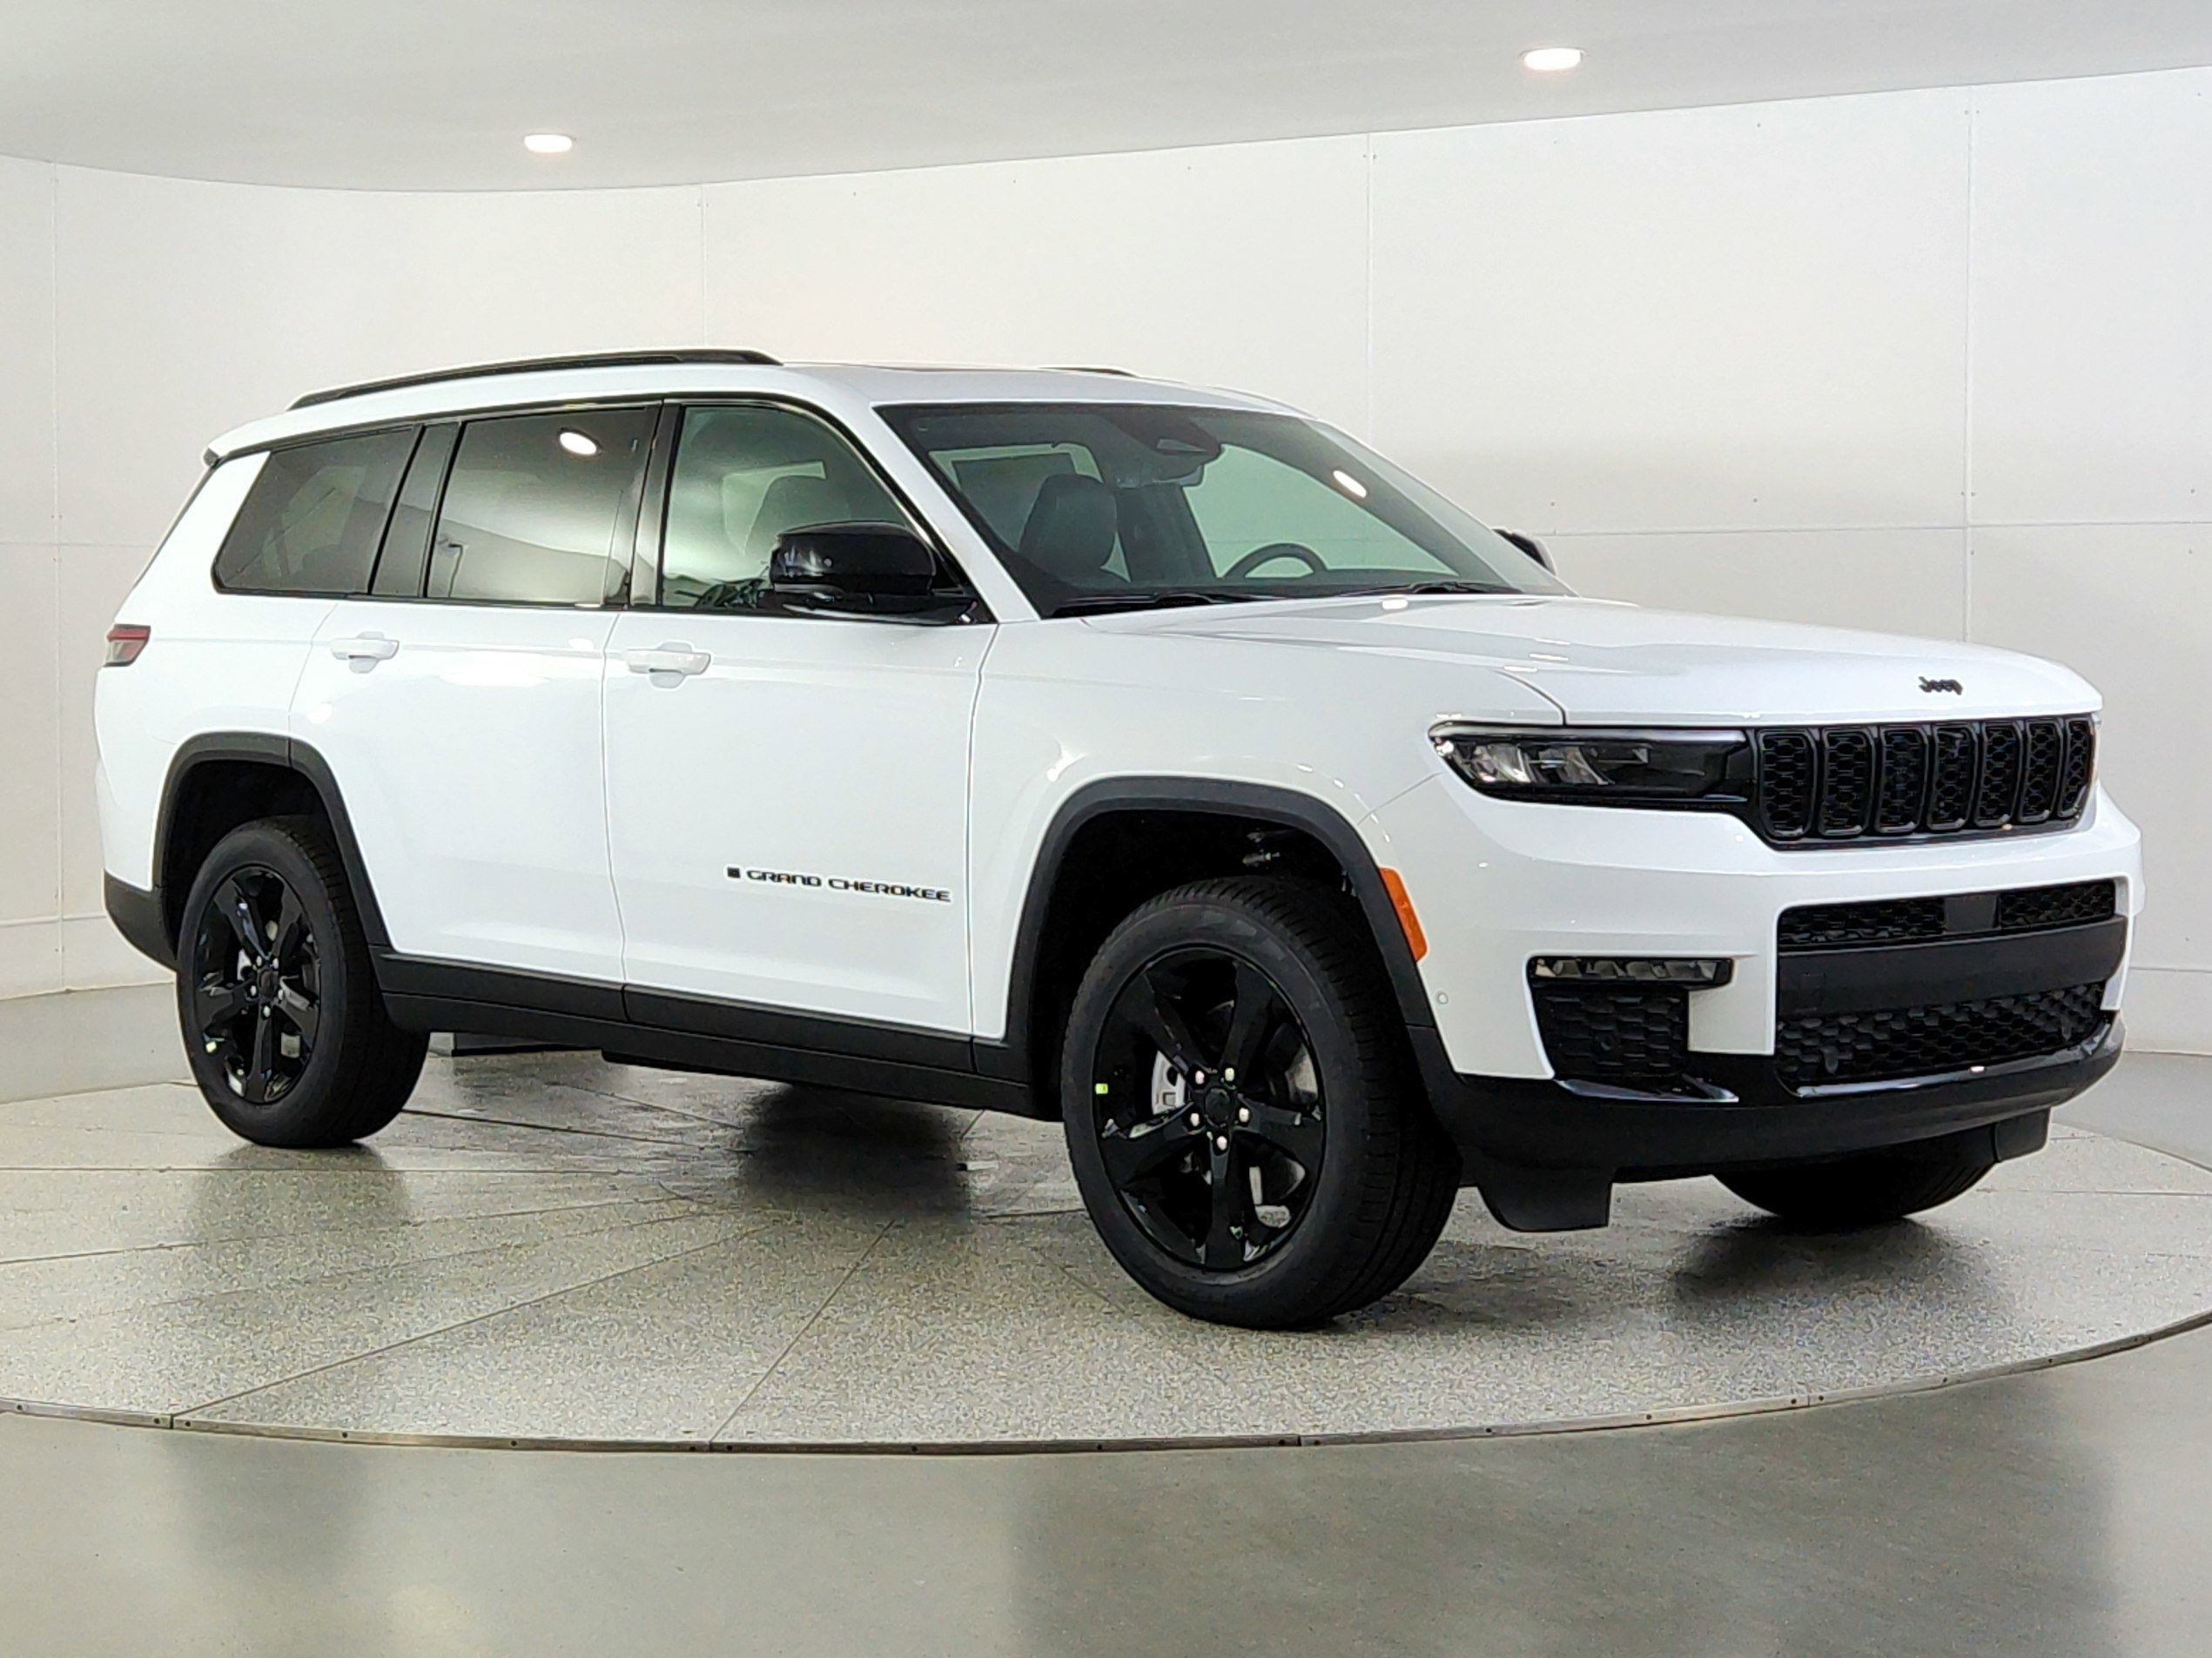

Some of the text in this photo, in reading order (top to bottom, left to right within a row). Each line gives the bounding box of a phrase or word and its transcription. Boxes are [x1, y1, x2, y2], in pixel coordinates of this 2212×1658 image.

[1918, 676, 1963, 695] Jeep
[746, 869, 951, 902] GRAND CHEROKEE
